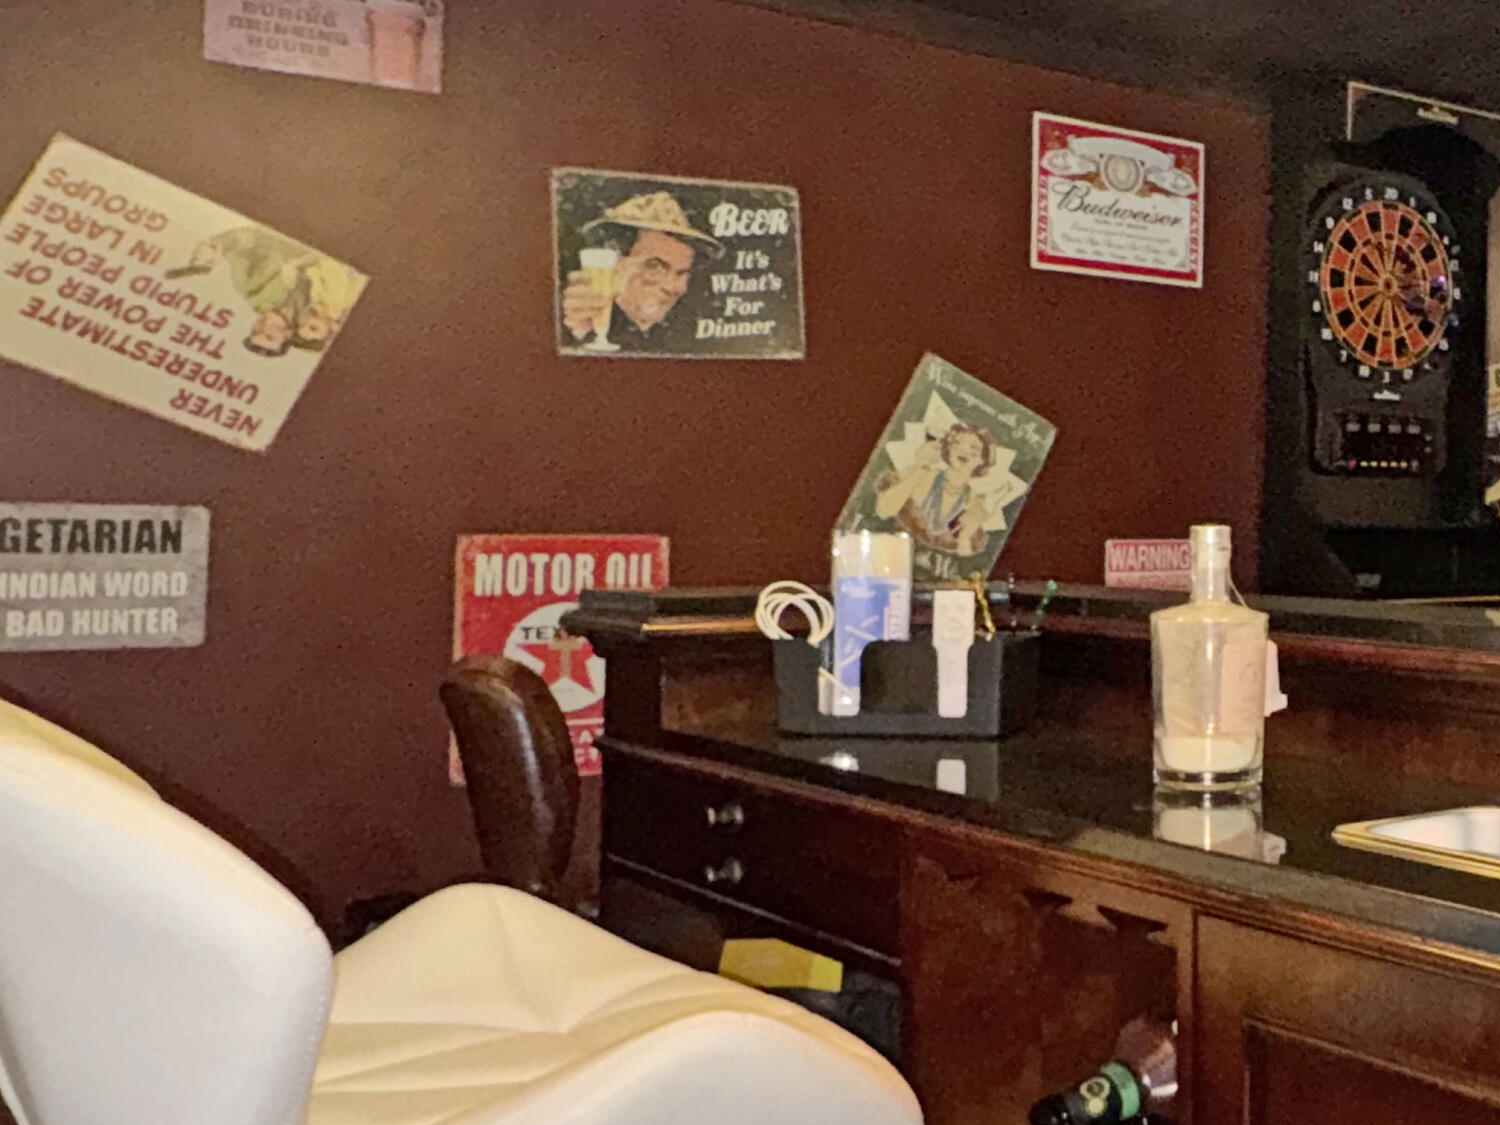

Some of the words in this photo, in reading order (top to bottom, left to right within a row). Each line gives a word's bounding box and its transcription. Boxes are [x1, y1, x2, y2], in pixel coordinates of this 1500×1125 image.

[43, 167, 169, 232] GROUPS
[1052, 180, 1183, 227] Budweiser
[23, 194, 125, 251] LARGE
[709, 202, 789, 237] BEER
[3, 222, 124, 280] PEOPLE
[128, 240, 164, 266] IN
[735, 250, 770, 270] It's
[4, 260, 52, 286] OF
[710, 272, 783, 293] What's
[57, 276, 166, 332] POWER
[130, 274, 234, 329] STUPID
[724, 296, 764, 316] For
[170, 322, 227, 361] THE
[695, 318, 777, 339] Dinner
[20, 296, 260, 405] UNDERESTIMATE
[170, 388, 262, 437] NEVER
[0, 516, 183, 554] GETARIAN
[473, 552, 596, 597] MOTOR
[1109, 543, 1190, 572] WARNING
[0, 570, 97, 599] INDIAN
[103, 570, 188, 598] WORD
[6, 610, 64, 637] BAD
[72, 607, 178, 636] HUNTER
